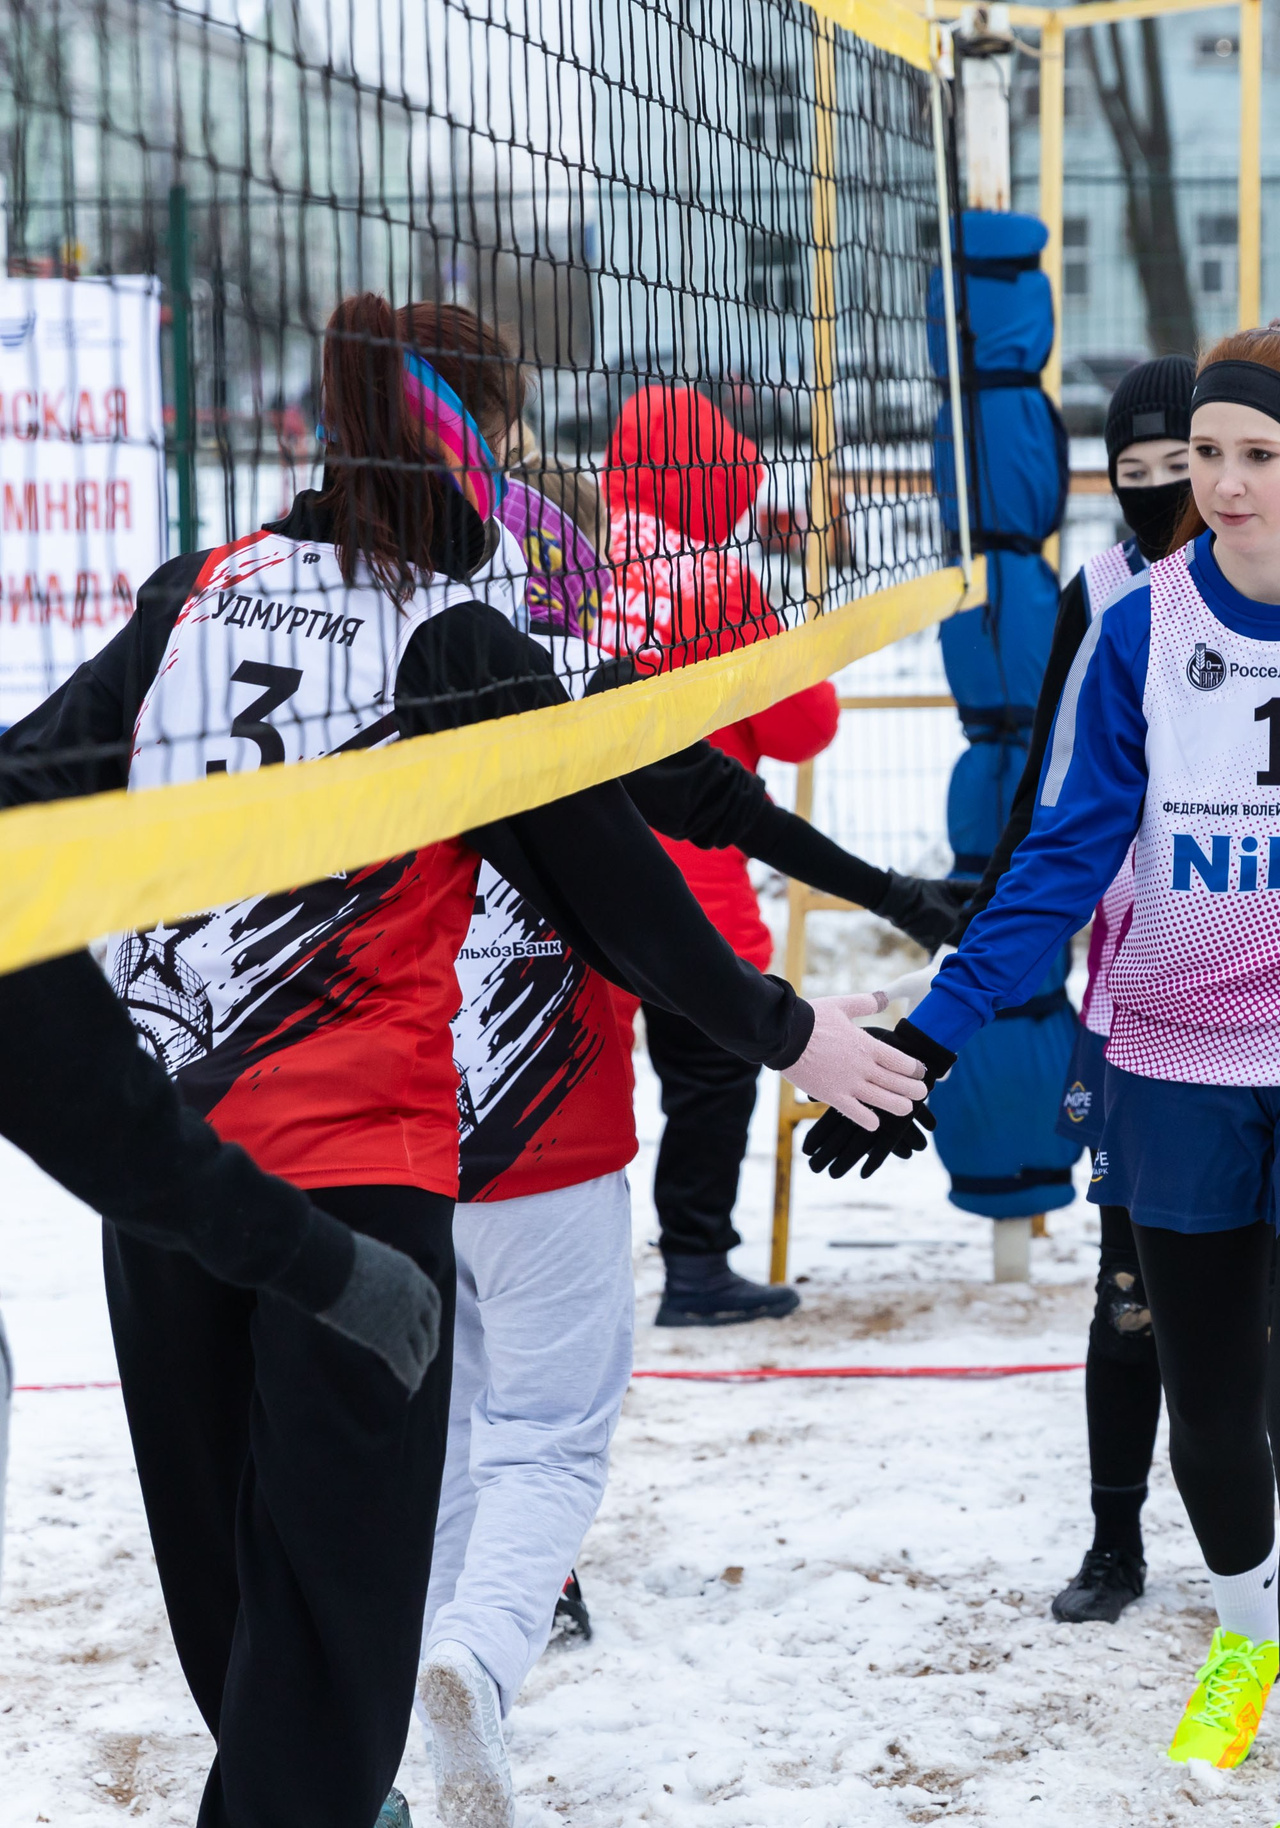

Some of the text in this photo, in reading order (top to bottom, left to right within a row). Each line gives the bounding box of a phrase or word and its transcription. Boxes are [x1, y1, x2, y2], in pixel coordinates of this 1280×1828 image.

[0, 386, 129, 441] СКАЯ
[0, 571, 136, 629] ИАДА
[211, 592, 365, 647] УДМУРТИЯ
[206, 660, 304, 779] 3
[1163, 801, 1238, 816] ФЕДЕРАЦИЯ
[458, 941, 562, 960] льхозБанк
